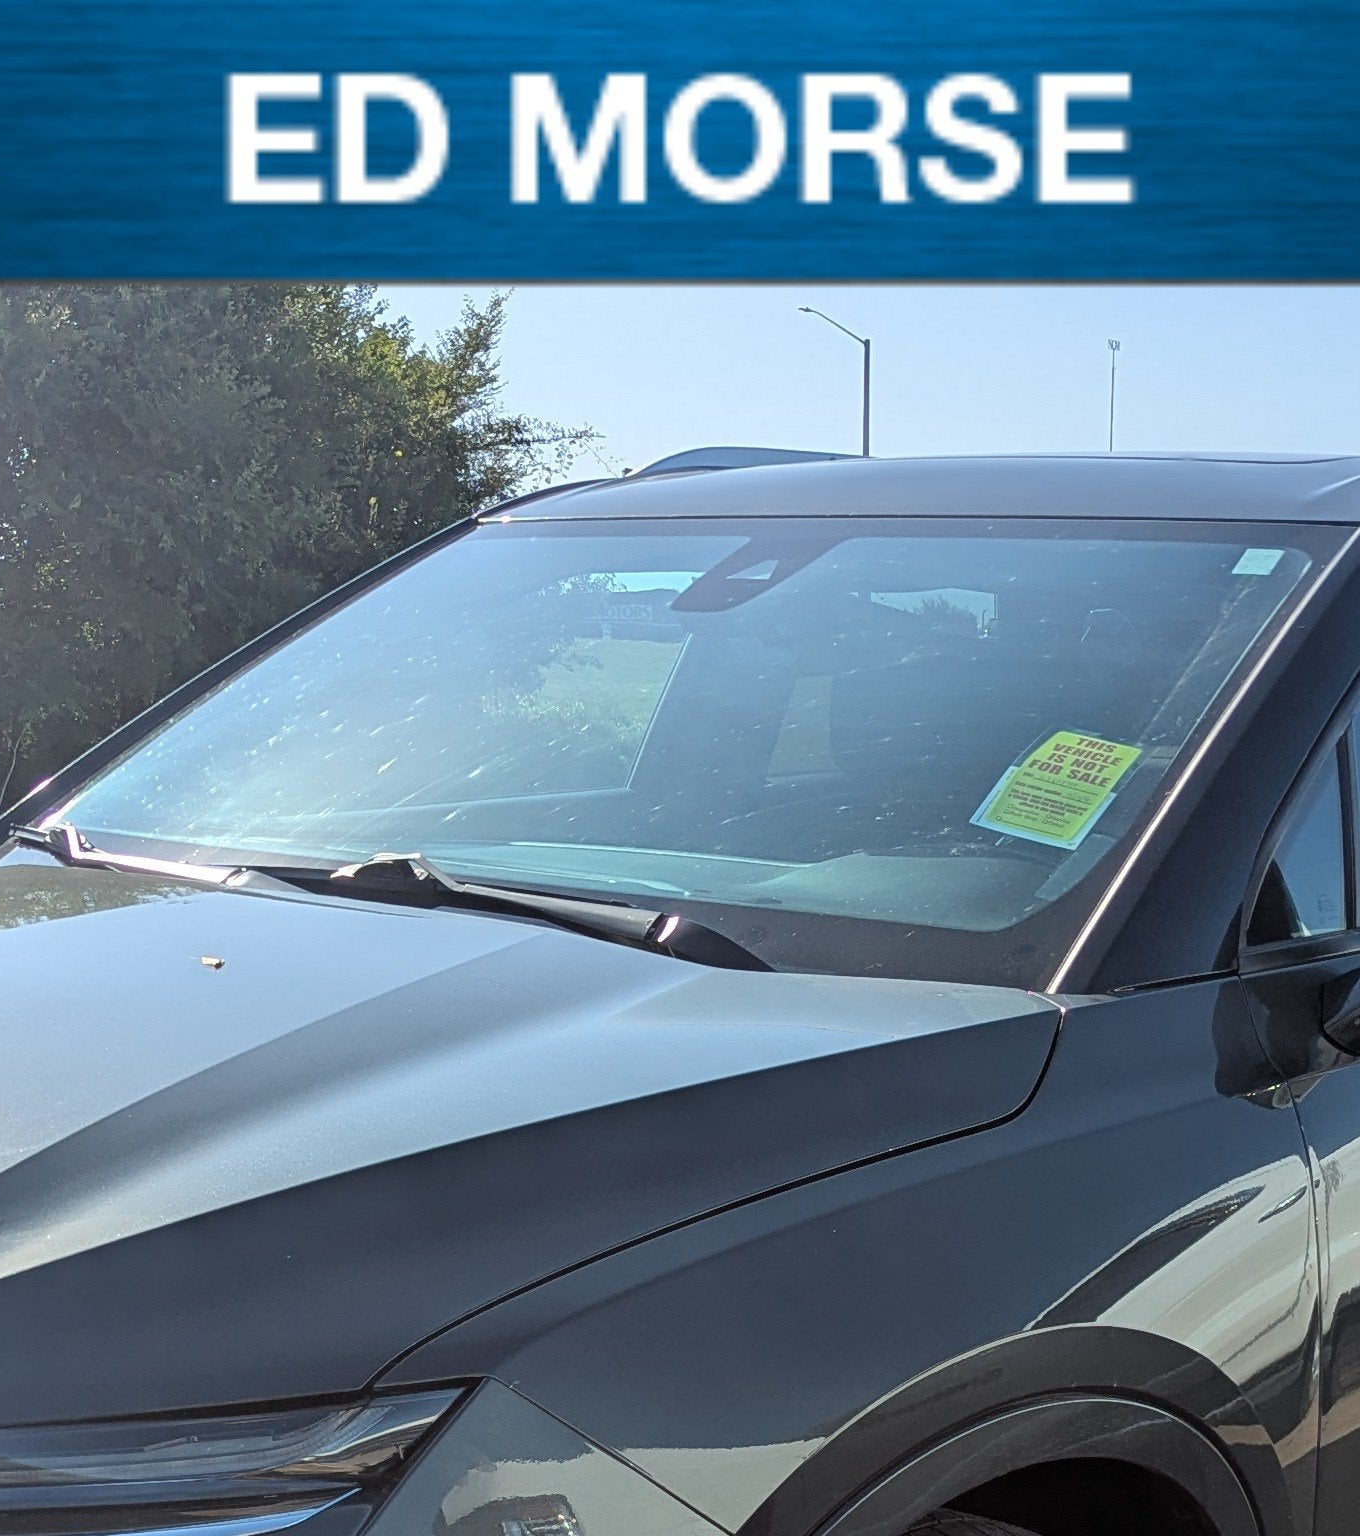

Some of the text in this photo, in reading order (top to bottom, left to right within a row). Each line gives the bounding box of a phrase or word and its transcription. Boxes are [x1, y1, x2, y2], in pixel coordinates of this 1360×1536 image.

[1053, 743, 1123, 766] VEHICLE
[1077, 737, 1117, 753] THIS
[1028, 759, 1063, 775] FOR
[1067, 769, 1111, 788] SALE
[1046, 752, 1110, 773] IS NOT
